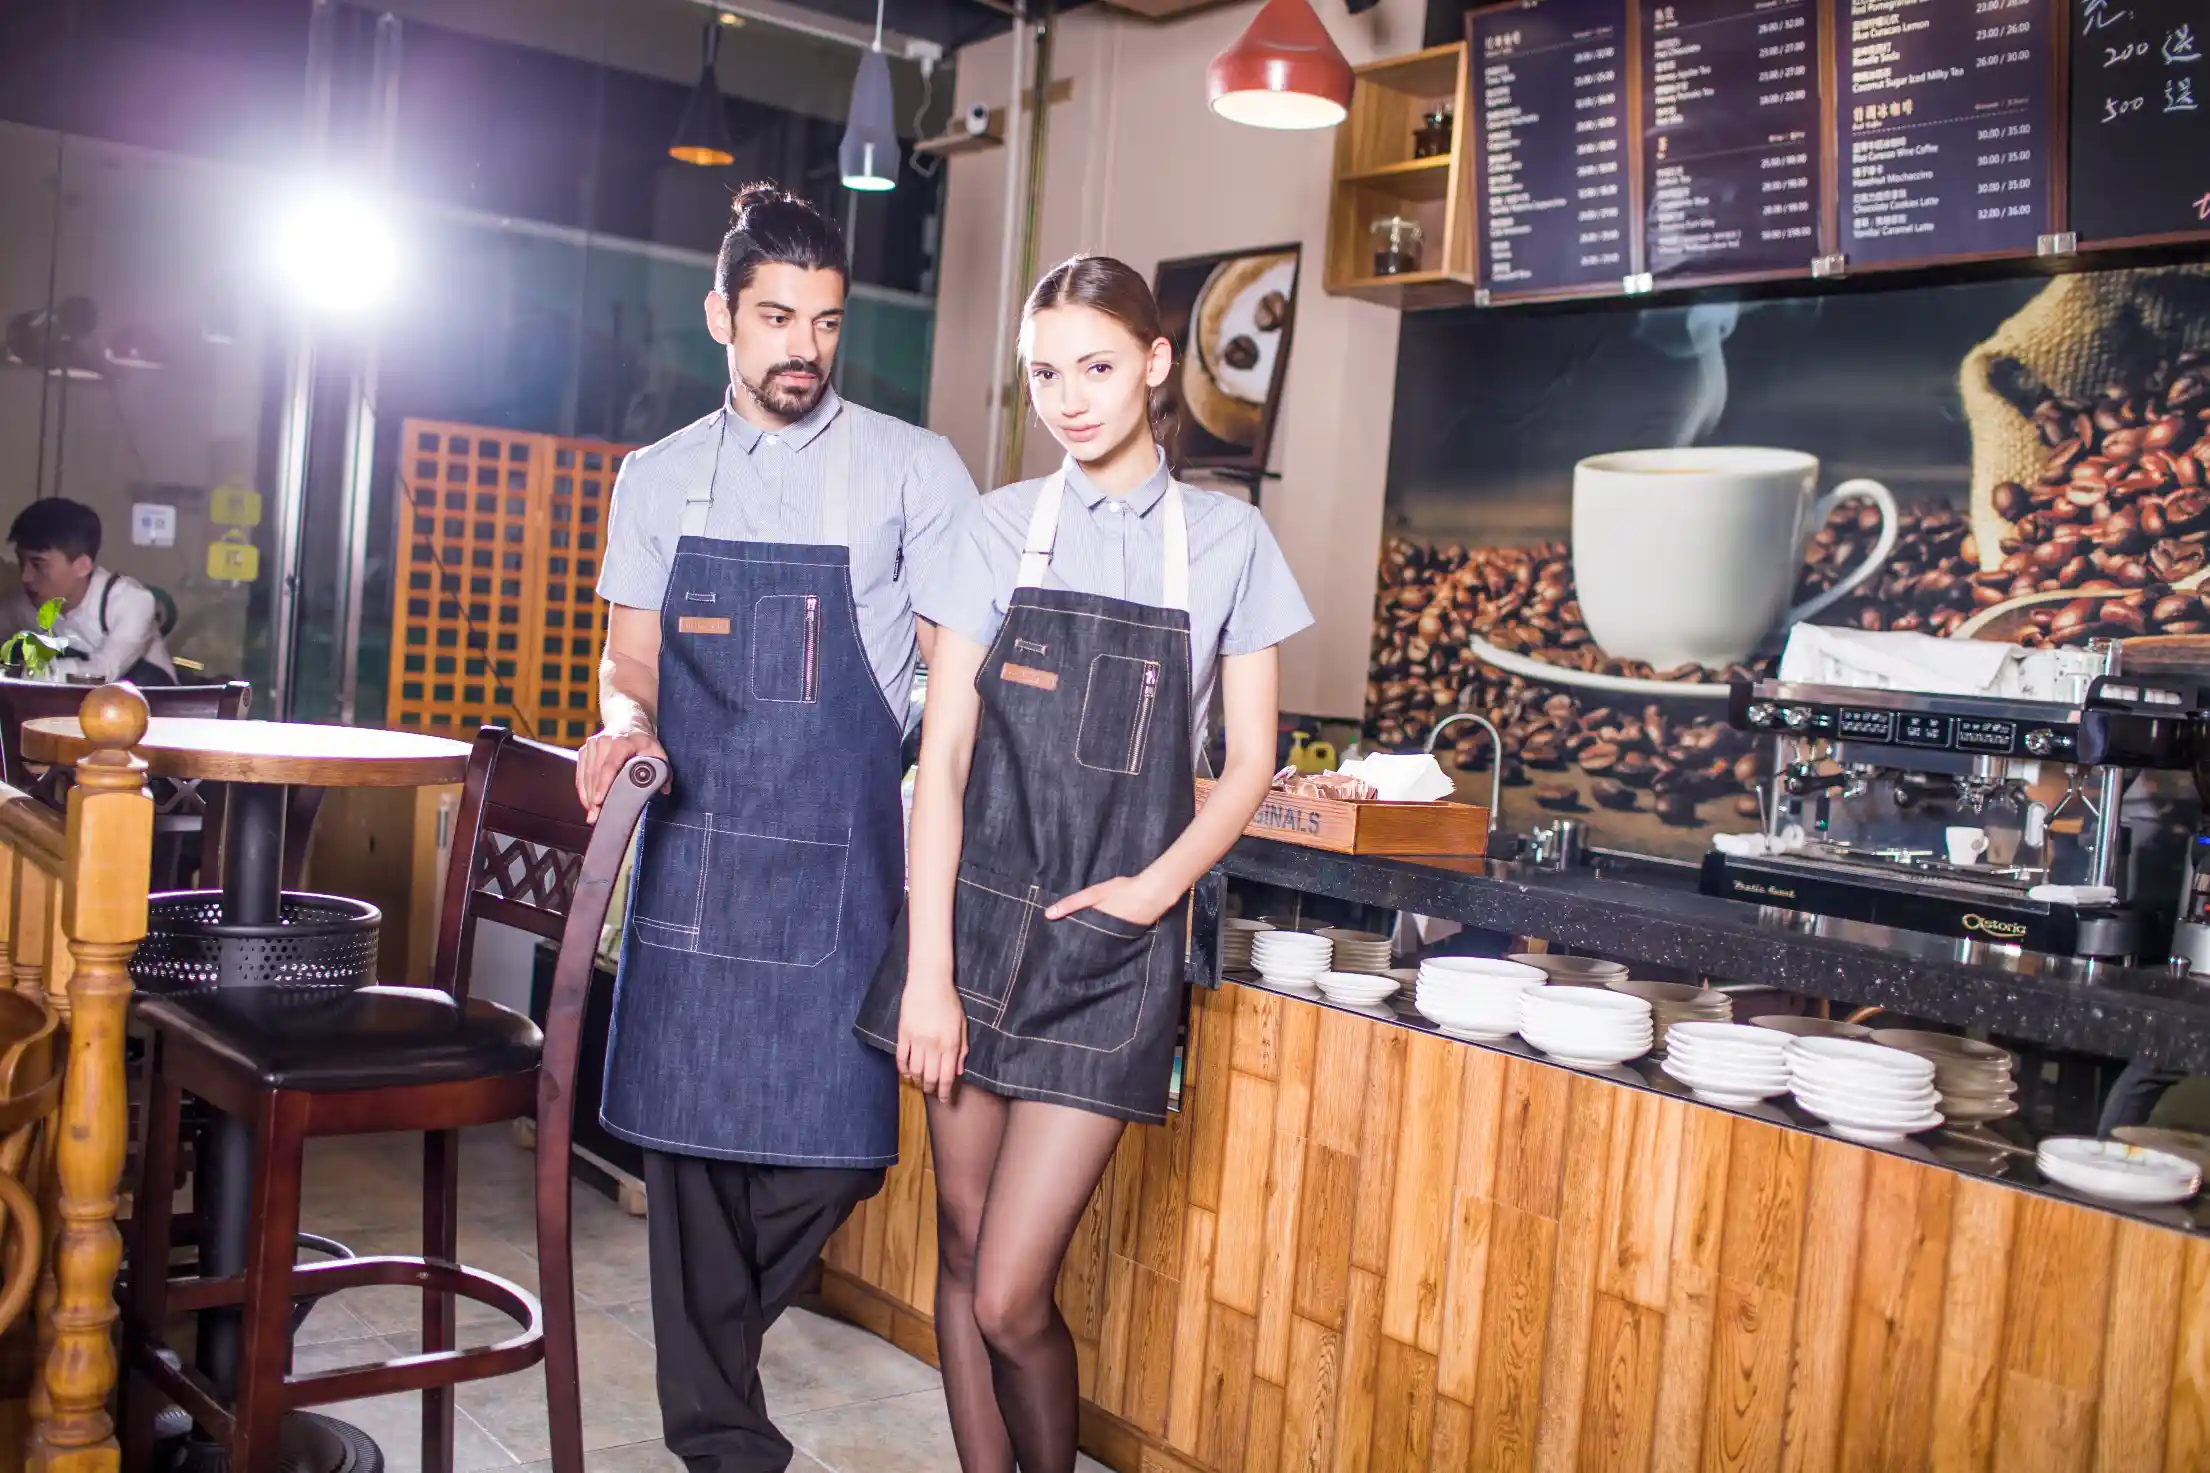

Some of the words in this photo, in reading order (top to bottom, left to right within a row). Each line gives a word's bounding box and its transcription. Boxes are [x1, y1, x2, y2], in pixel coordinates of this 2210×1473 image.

[1902, 20, 1930, 32] Lemon
[1976, 27, 1999, 40] 23.00
[2006, 22, 2030, 36] 26.00
[2103, 42, 2149, 68] 200
[2161, 23, 2202, 65] 送
[1976, 56, 1999, 68] 26.00
[2007, 50, 2030, 62] 30.00
[1885, 77, 1907, 90] Sugar
[1908, 72, 1925, 84] Iced
[1927, 69, 1949, 81] Milky
[1950, 67, 1964, 76] Tea
[2100, 96, 2144, 123] 500
[2162, 76, 2199, 113] 送
[1977, 127, 2000, 140] 30.00
[2007, 124, 2031, 138] 35.00
[1915, 143, 1938, 155] Coffee
[1977, 154, 2000, 167] 30.00
[2007, 150, 2031, 163] 35.00
[1977, 181, 2000, 194] 30.00
[2007, 178, 2031, 191] 35.00
[1920, 197, 1939, 207] Latte
[1977, 208, 2000, 220] 32.00
[2007, 204, 2031, 217] 36.00
[1915, 223, 1934, 232] Latte
